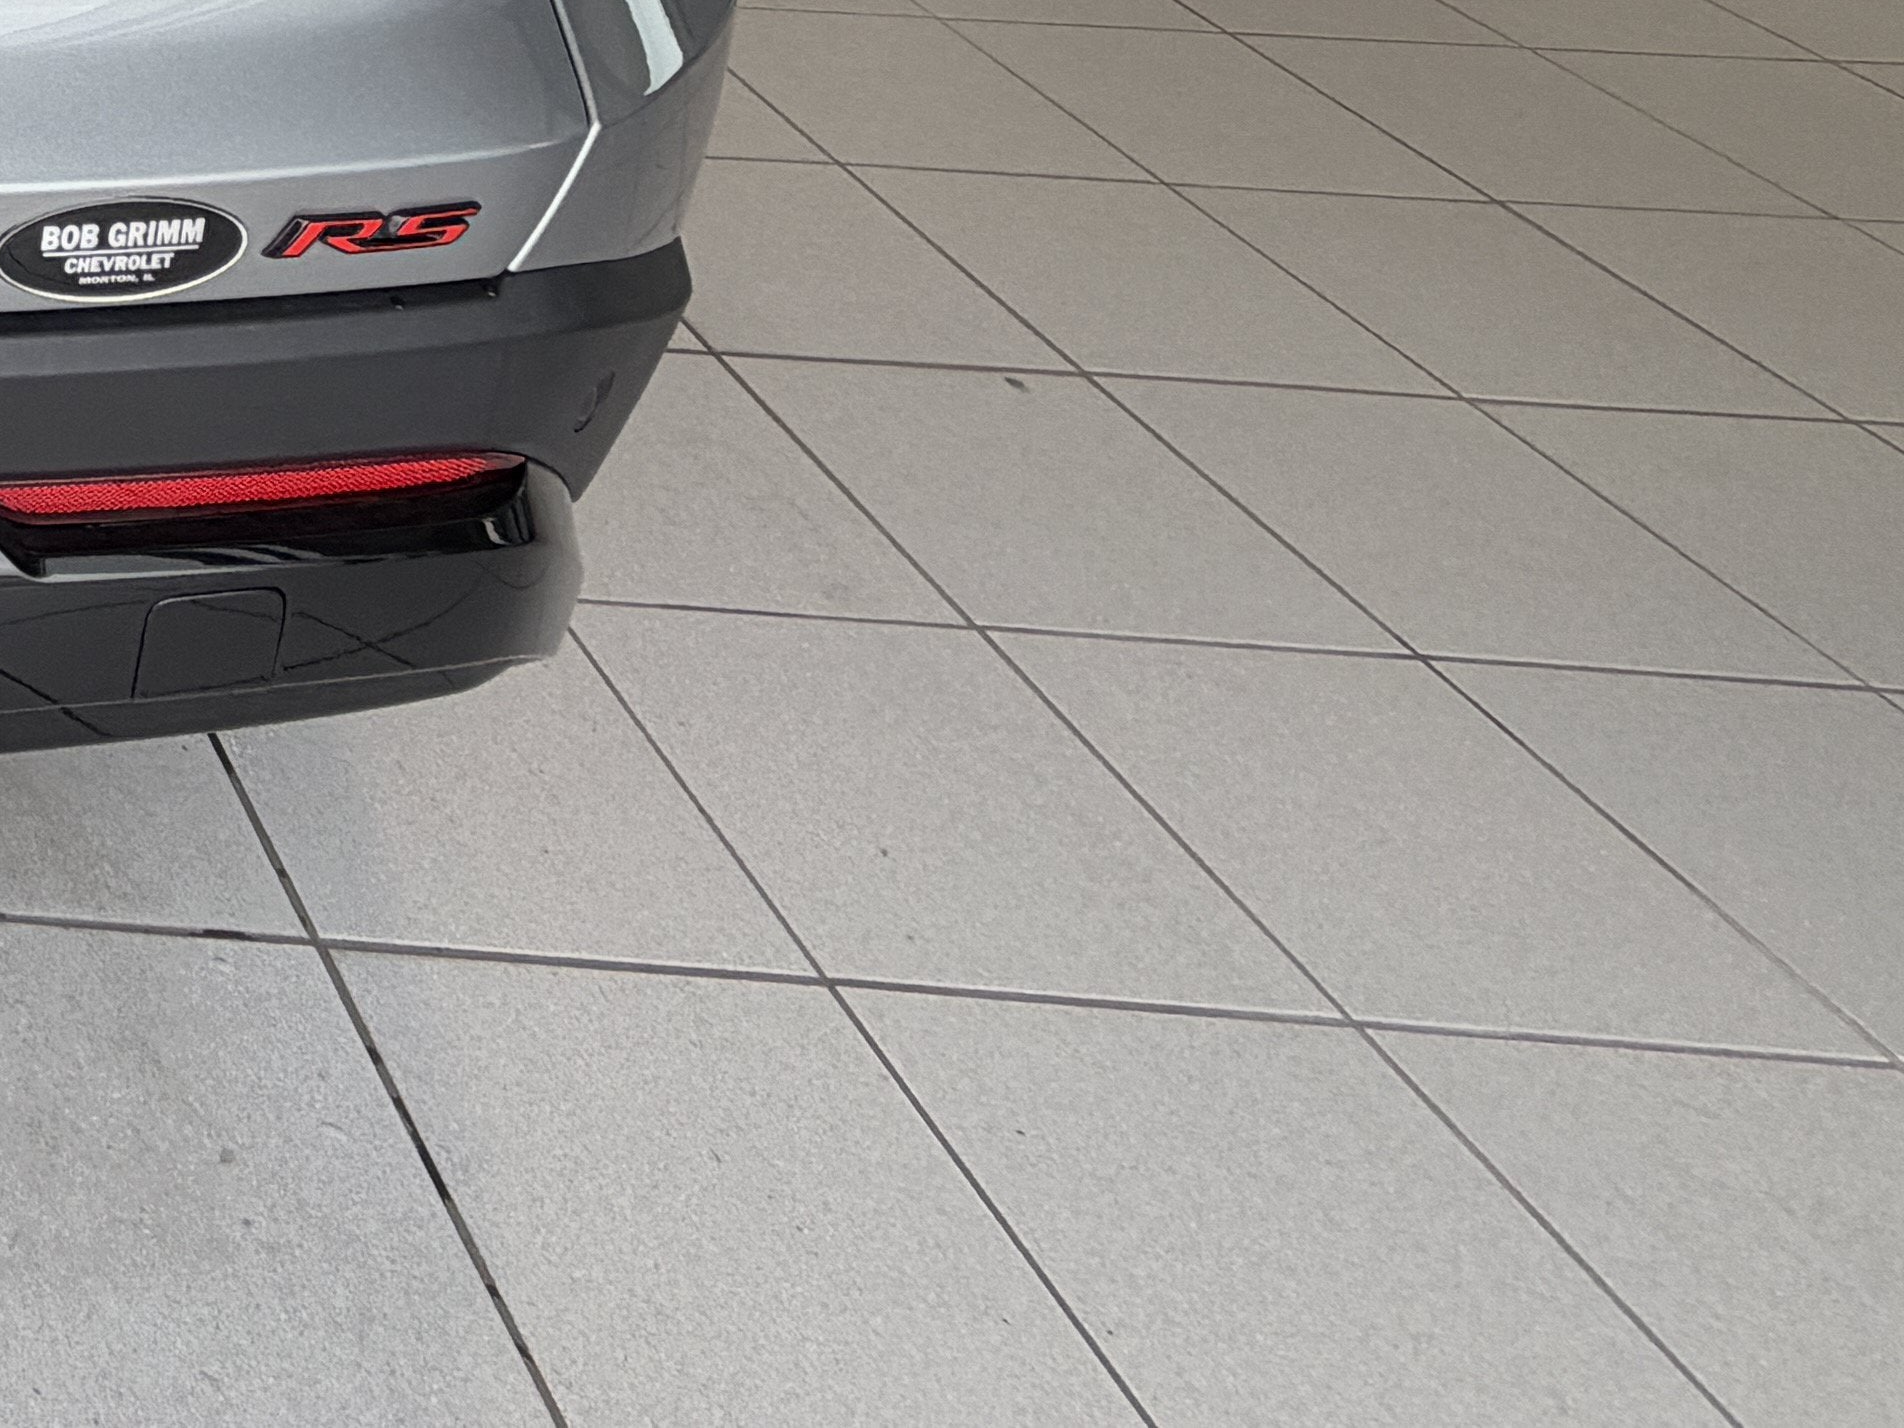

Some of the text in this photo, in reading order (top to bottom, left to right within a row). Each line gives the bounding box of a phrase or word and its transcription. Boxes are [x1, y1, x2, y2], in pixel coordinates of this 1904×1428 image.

[40, 217, 206, 251] BOB GRIMM
[261, 200, 482, 259] RS
[63, 252, 175, 274] CHEVROLET
